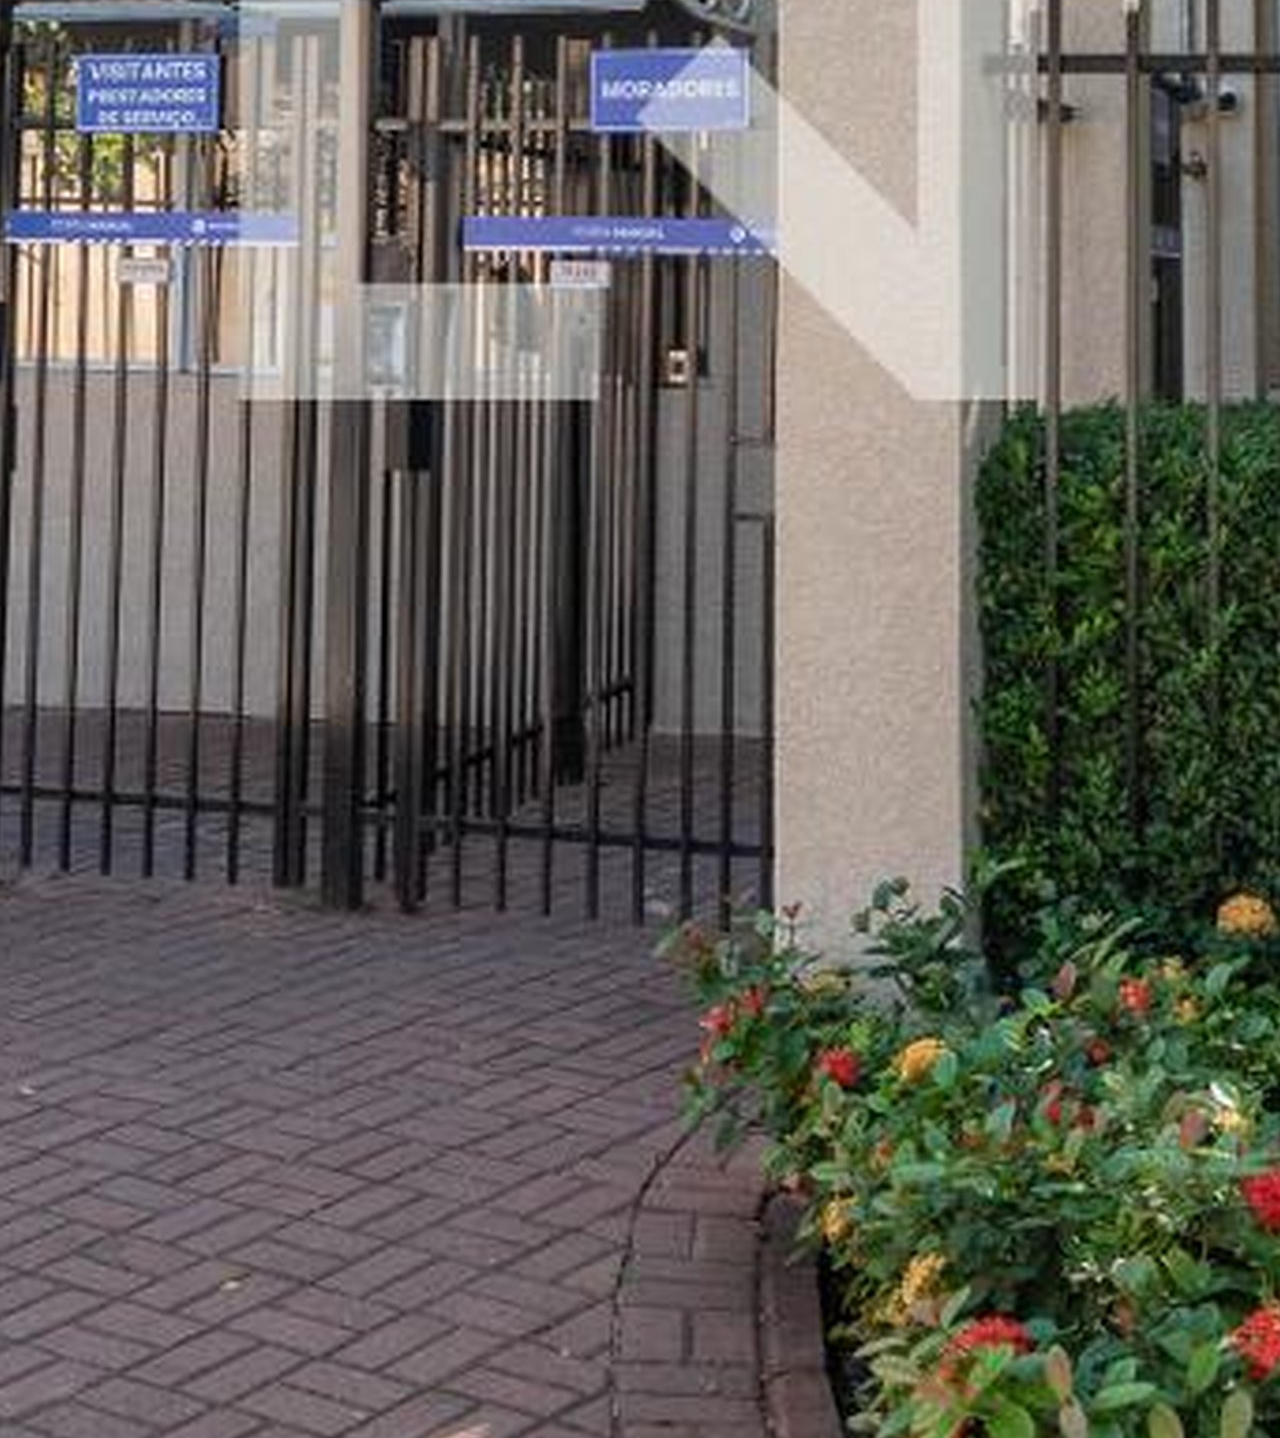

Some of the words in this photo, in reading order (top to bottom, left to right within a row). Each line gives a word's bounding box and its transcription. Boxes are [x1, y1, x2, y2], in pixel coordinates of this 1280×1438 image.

[86, 60, 207, 81] VISITANTES
[87, 87, 207, 105] PRESTADORES
[600, 78, 739, 99] MORADORES
